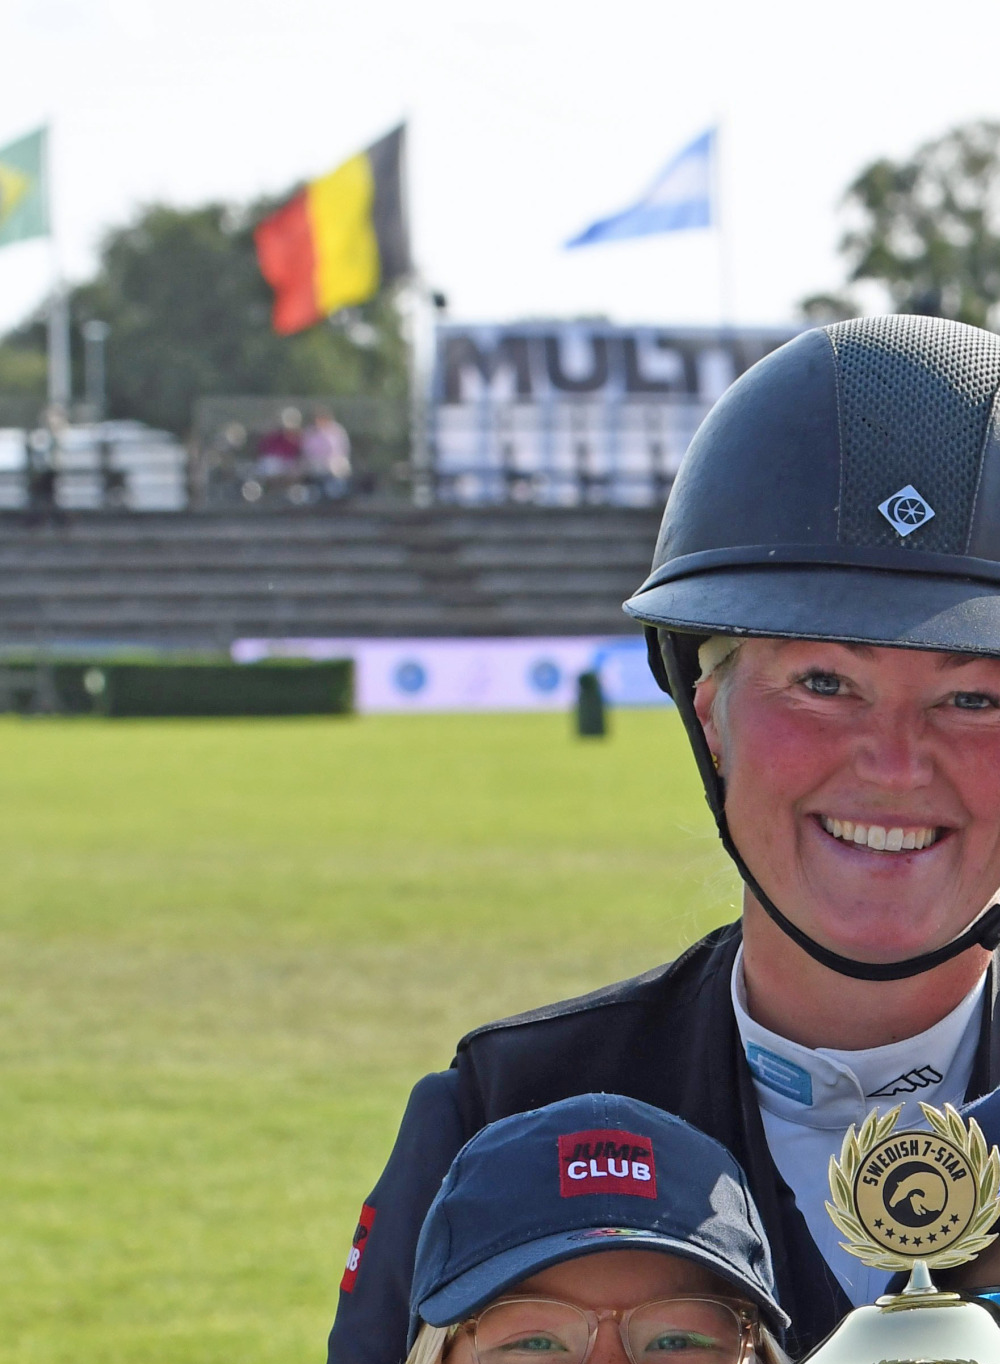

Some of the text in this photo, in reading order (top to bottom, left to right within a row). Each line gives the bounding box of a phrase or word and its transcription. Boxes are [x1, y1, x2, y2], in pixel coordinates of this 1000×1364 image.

[565, 1141, 651, 1162] JUMP
[862, 1139, 967, 1187] SWEDISH 7-STAR
[567, 1158, 651, 1181] CLUB
